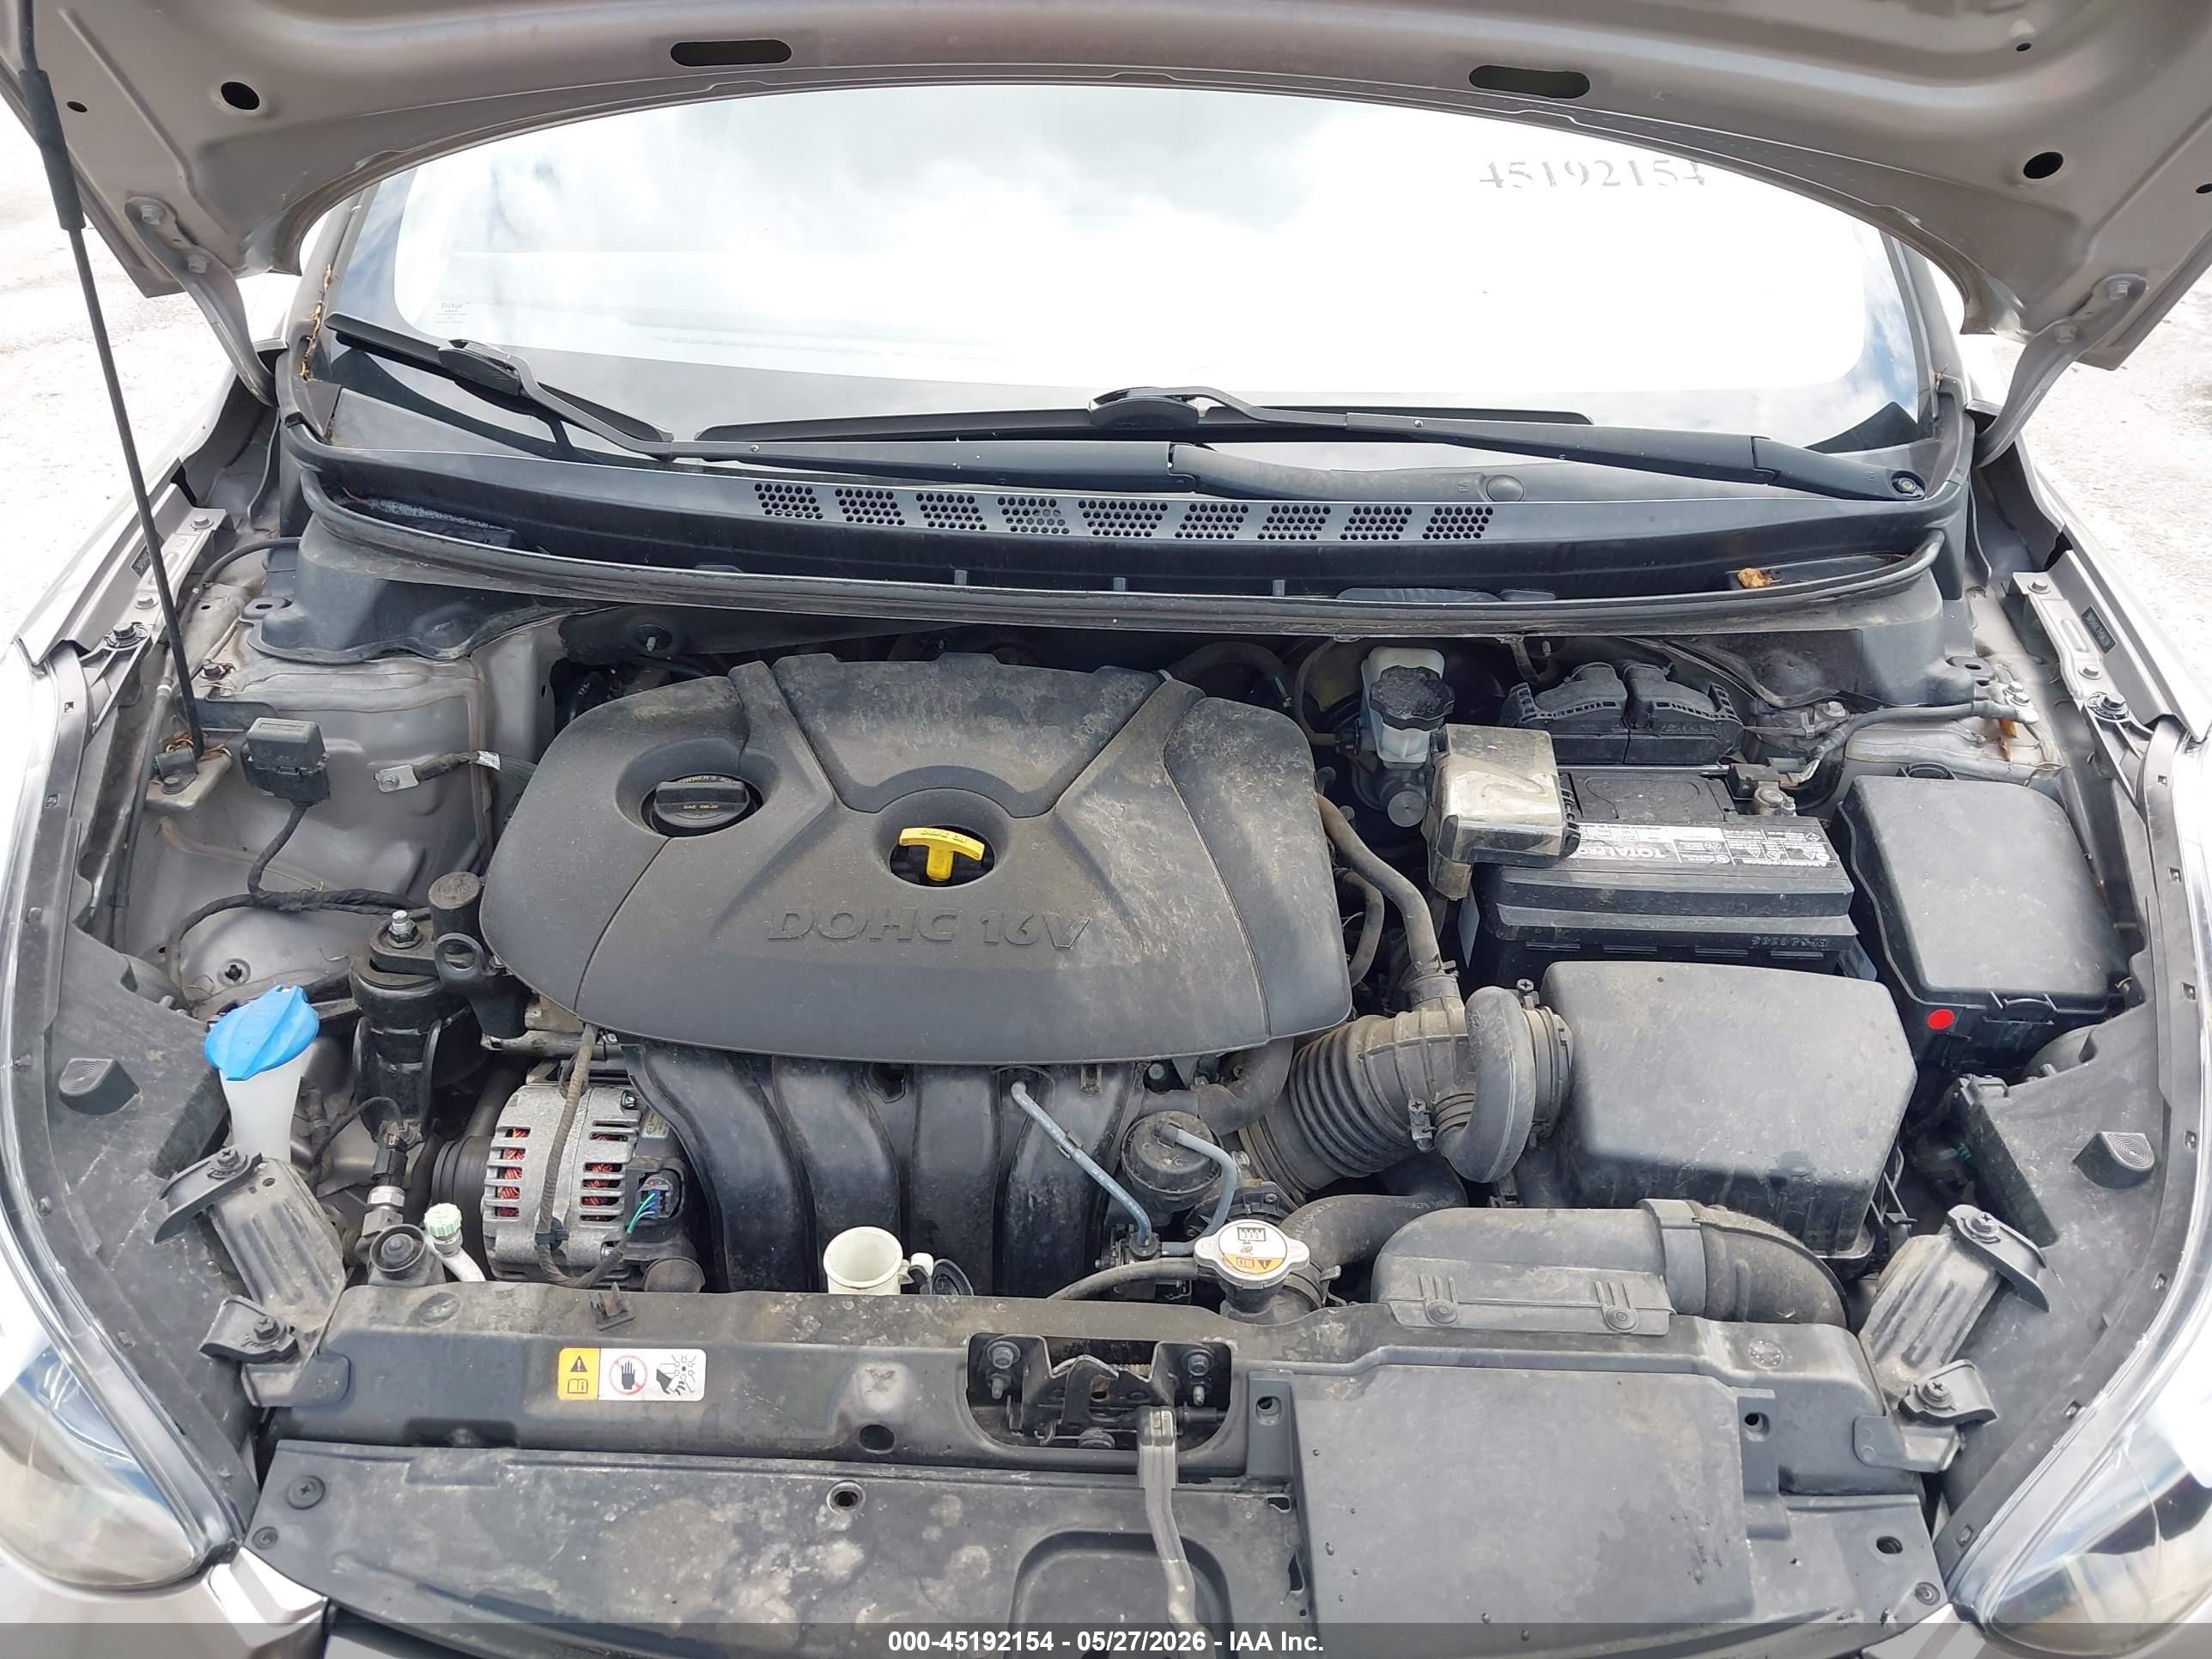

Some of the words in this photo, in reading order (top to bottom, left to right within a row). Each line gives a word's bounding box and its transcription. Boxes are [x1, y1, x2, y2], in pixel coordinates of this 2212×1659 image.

[1480, 160, 1705, 188] 45192154
[767, 907, 957, 942] DOHC
[981, 908, 1094, 950] 16V
